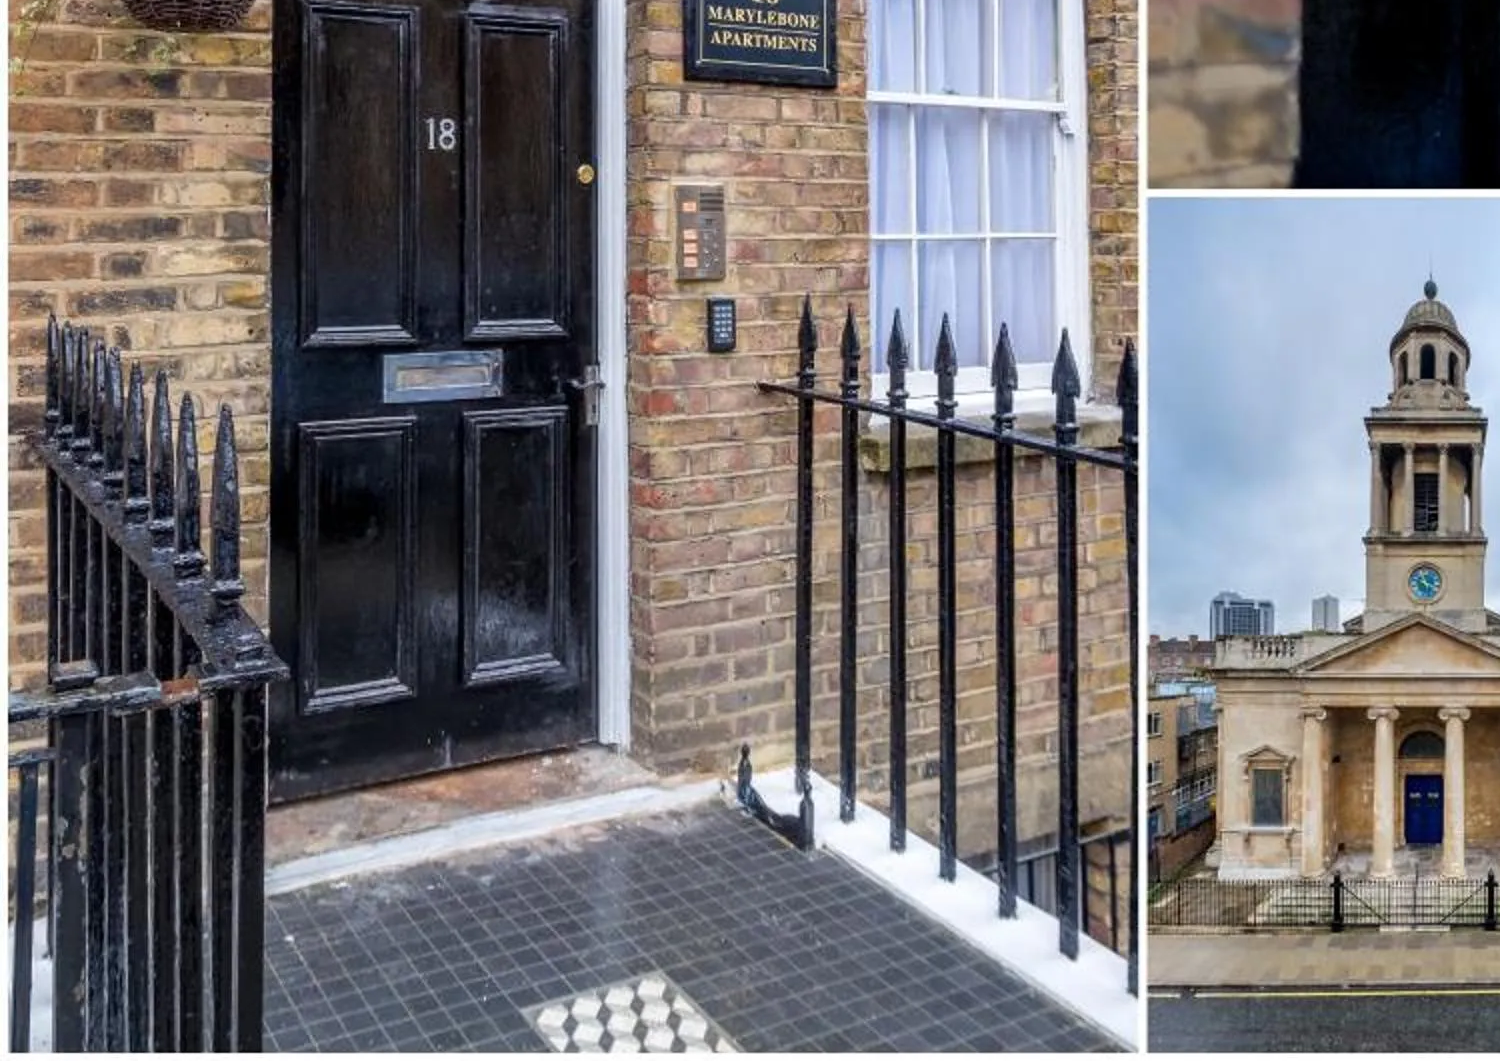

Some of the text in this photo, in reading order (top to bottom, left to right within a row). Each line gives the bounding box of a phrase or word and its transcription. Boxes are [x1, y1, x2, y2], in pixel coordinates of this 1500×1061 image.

[707, 5, 820, 29] MARYLEBONE
[710, 30, 817, 52] APARTMENTS
[424, 117, 456, 150] 18
